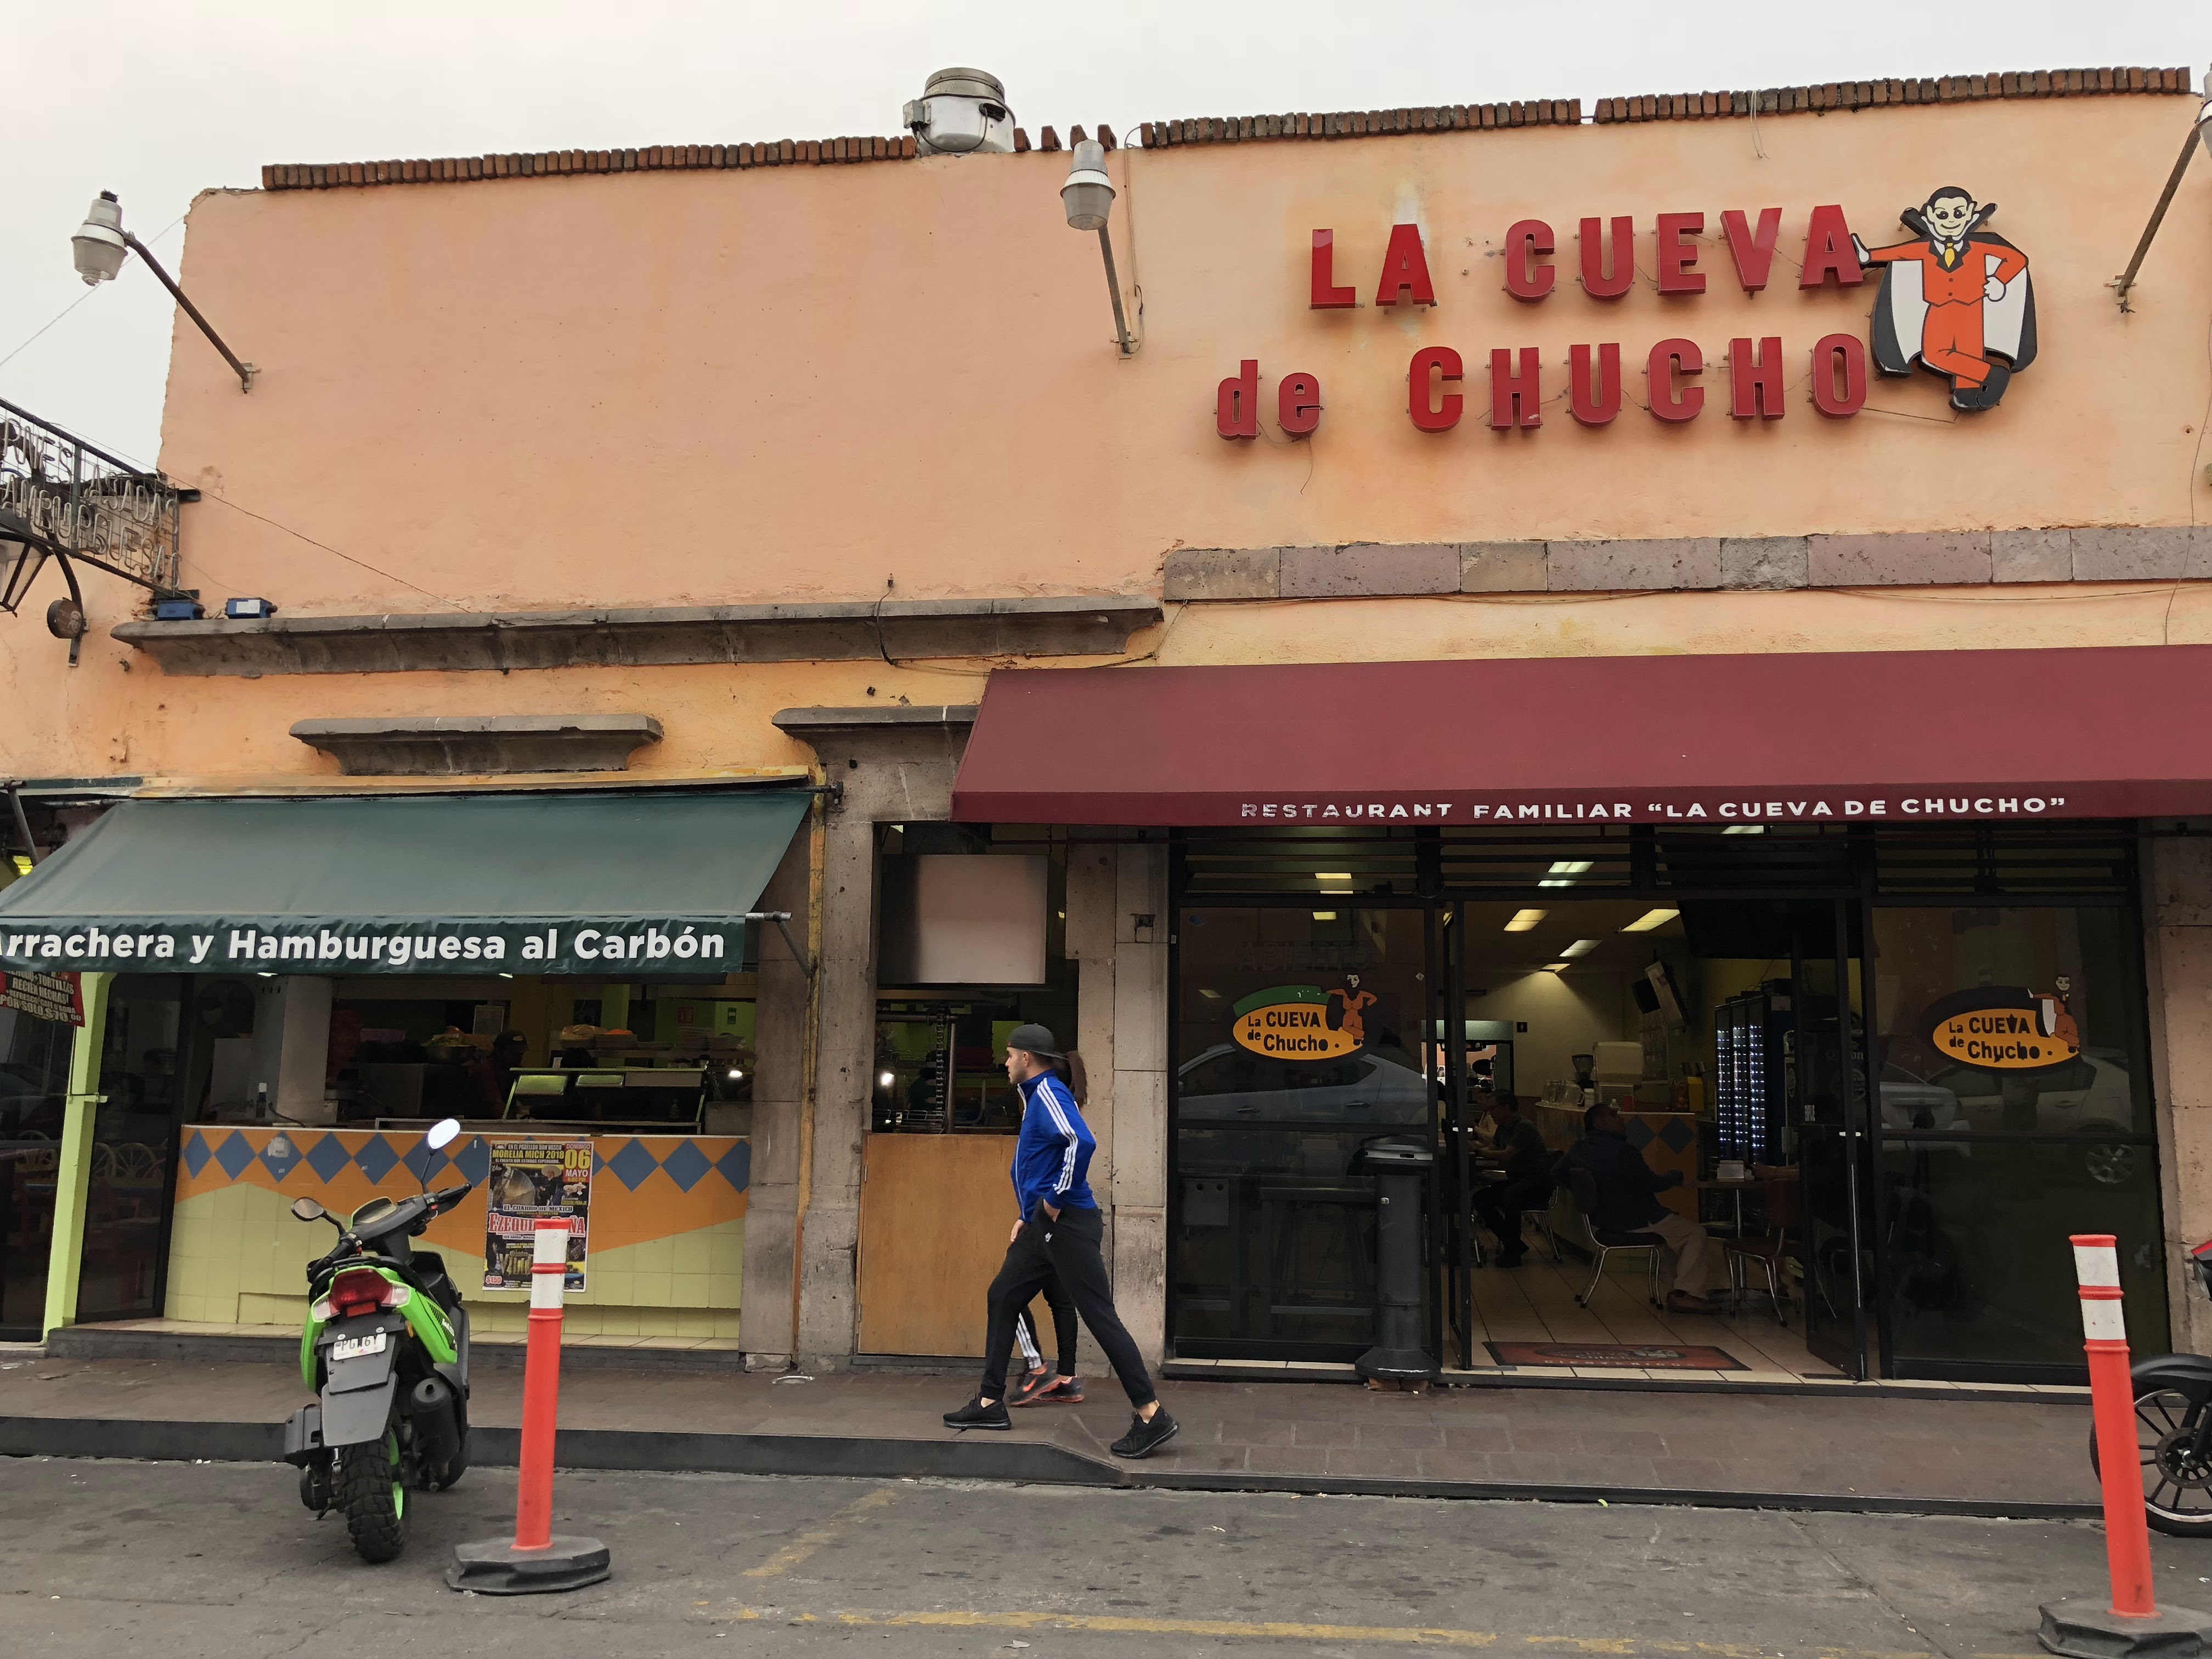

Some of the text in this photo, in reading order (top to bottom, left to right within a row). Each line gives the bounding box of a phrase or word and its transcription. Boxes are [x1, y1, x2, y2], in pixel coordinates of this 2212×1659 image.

[1310, 205, 1865, 309] LA CUEVA
[1217, 333, 1866, 439] de CHUCHO
[1241, 804, 1453, 819] RESTAURANT
[1474, 804, 1632, 819] FAMILIAR
[1719, 802, 1833, 817] CUEVA
[1845, 800, 1887, 816] DE
[190, 936, 215, 964] y
[228, 928, 504, 964] Hamburguesa
[522, 928, 557, 958] al
[574, 925, 725, 960] Carbón
[0, 994, 20, 1009] POR
[21, 1000, 44, 1017] SOLO
[1248, 1011, 1321, 1028] La CUEVA
[1949, 1015, 2031, 1034] La CUEVA
[1247, 1029, 1329, 1052] de Chucho
[1949, 1036, 1964, 1048] de
[492, 1149, 565, 1159] MORELIA MICH 2018
[565, 1149, 591, 1169] 06
[489, 1214, 535, 1232] EZEQUI
